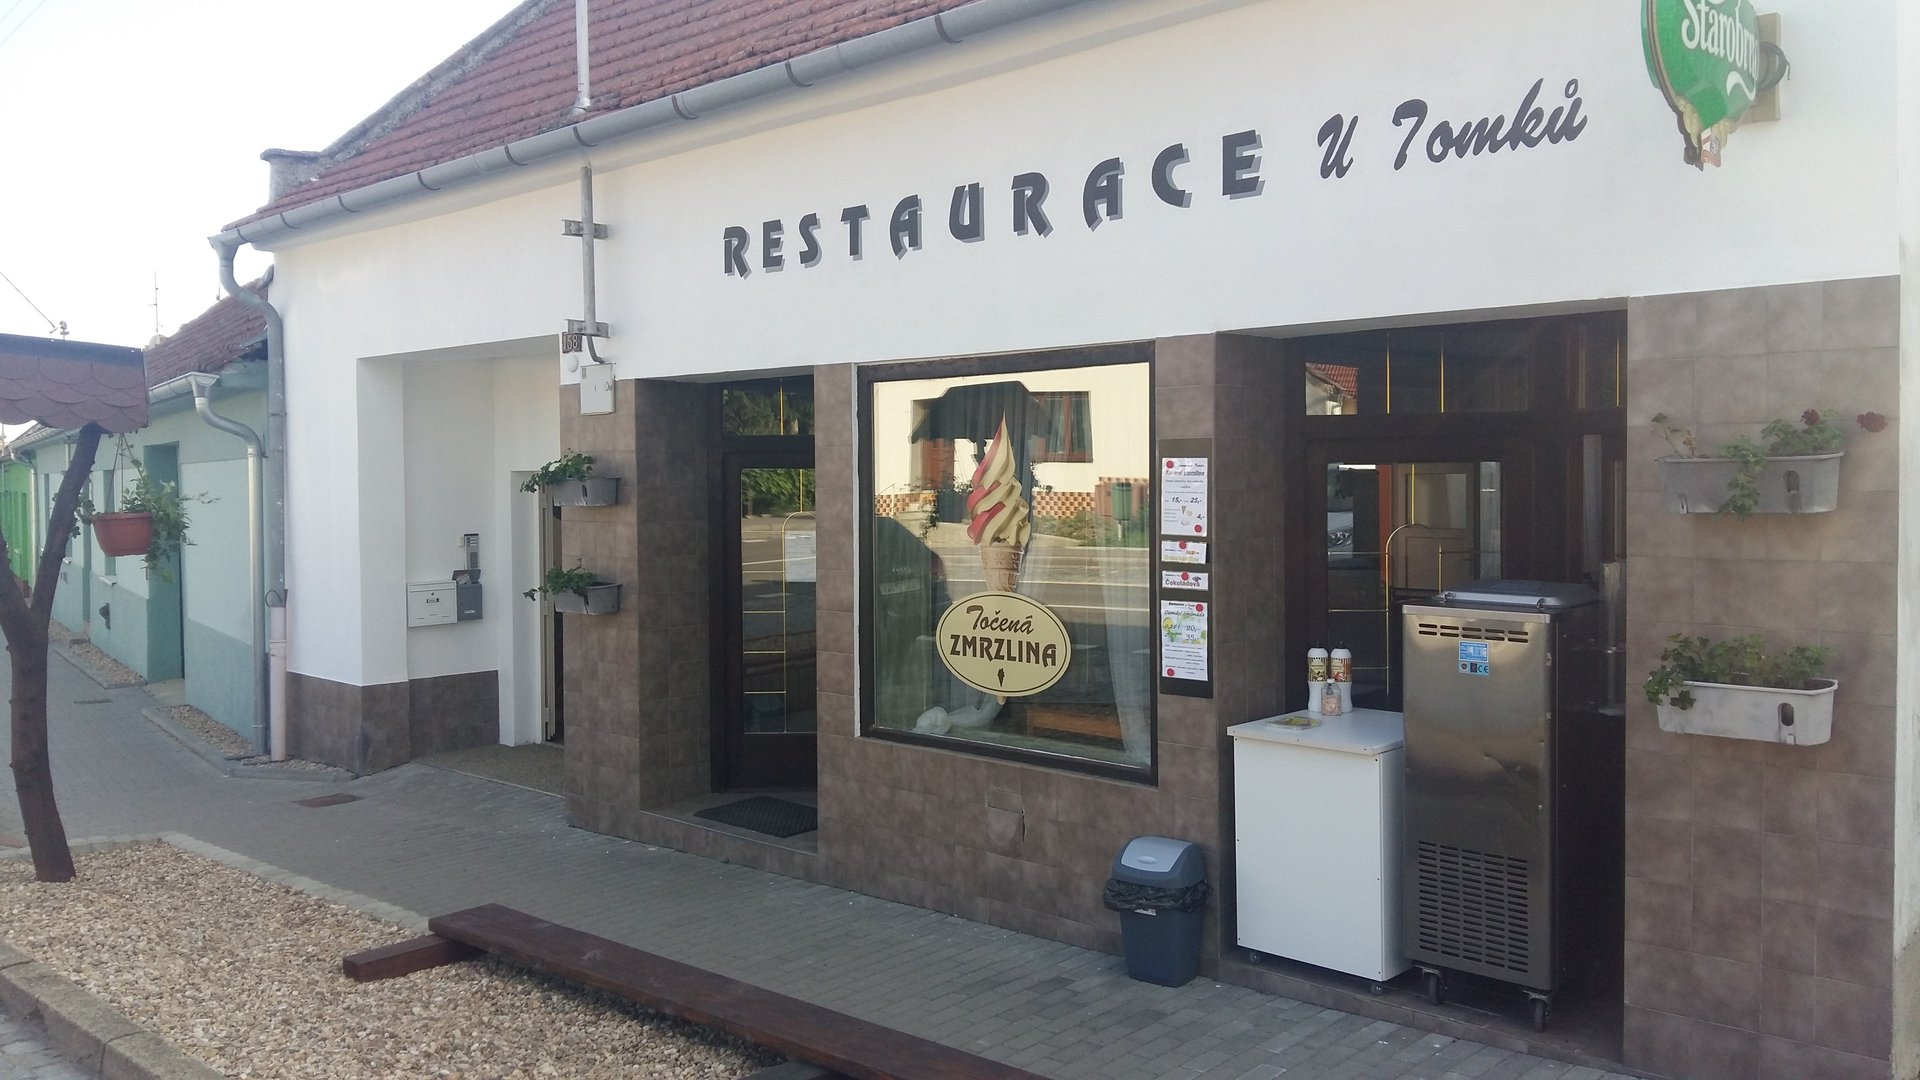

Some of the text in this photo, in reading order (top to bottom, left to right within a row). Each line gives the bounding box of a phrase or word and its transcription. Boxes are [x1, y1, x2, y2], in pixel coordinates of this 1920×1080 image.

[722, 77, 1588, 280] RESTAURACE U Tomků
[966, 604, 1035, 635] Točená
[949, 633, 1057, 668] ZMRZLINA
